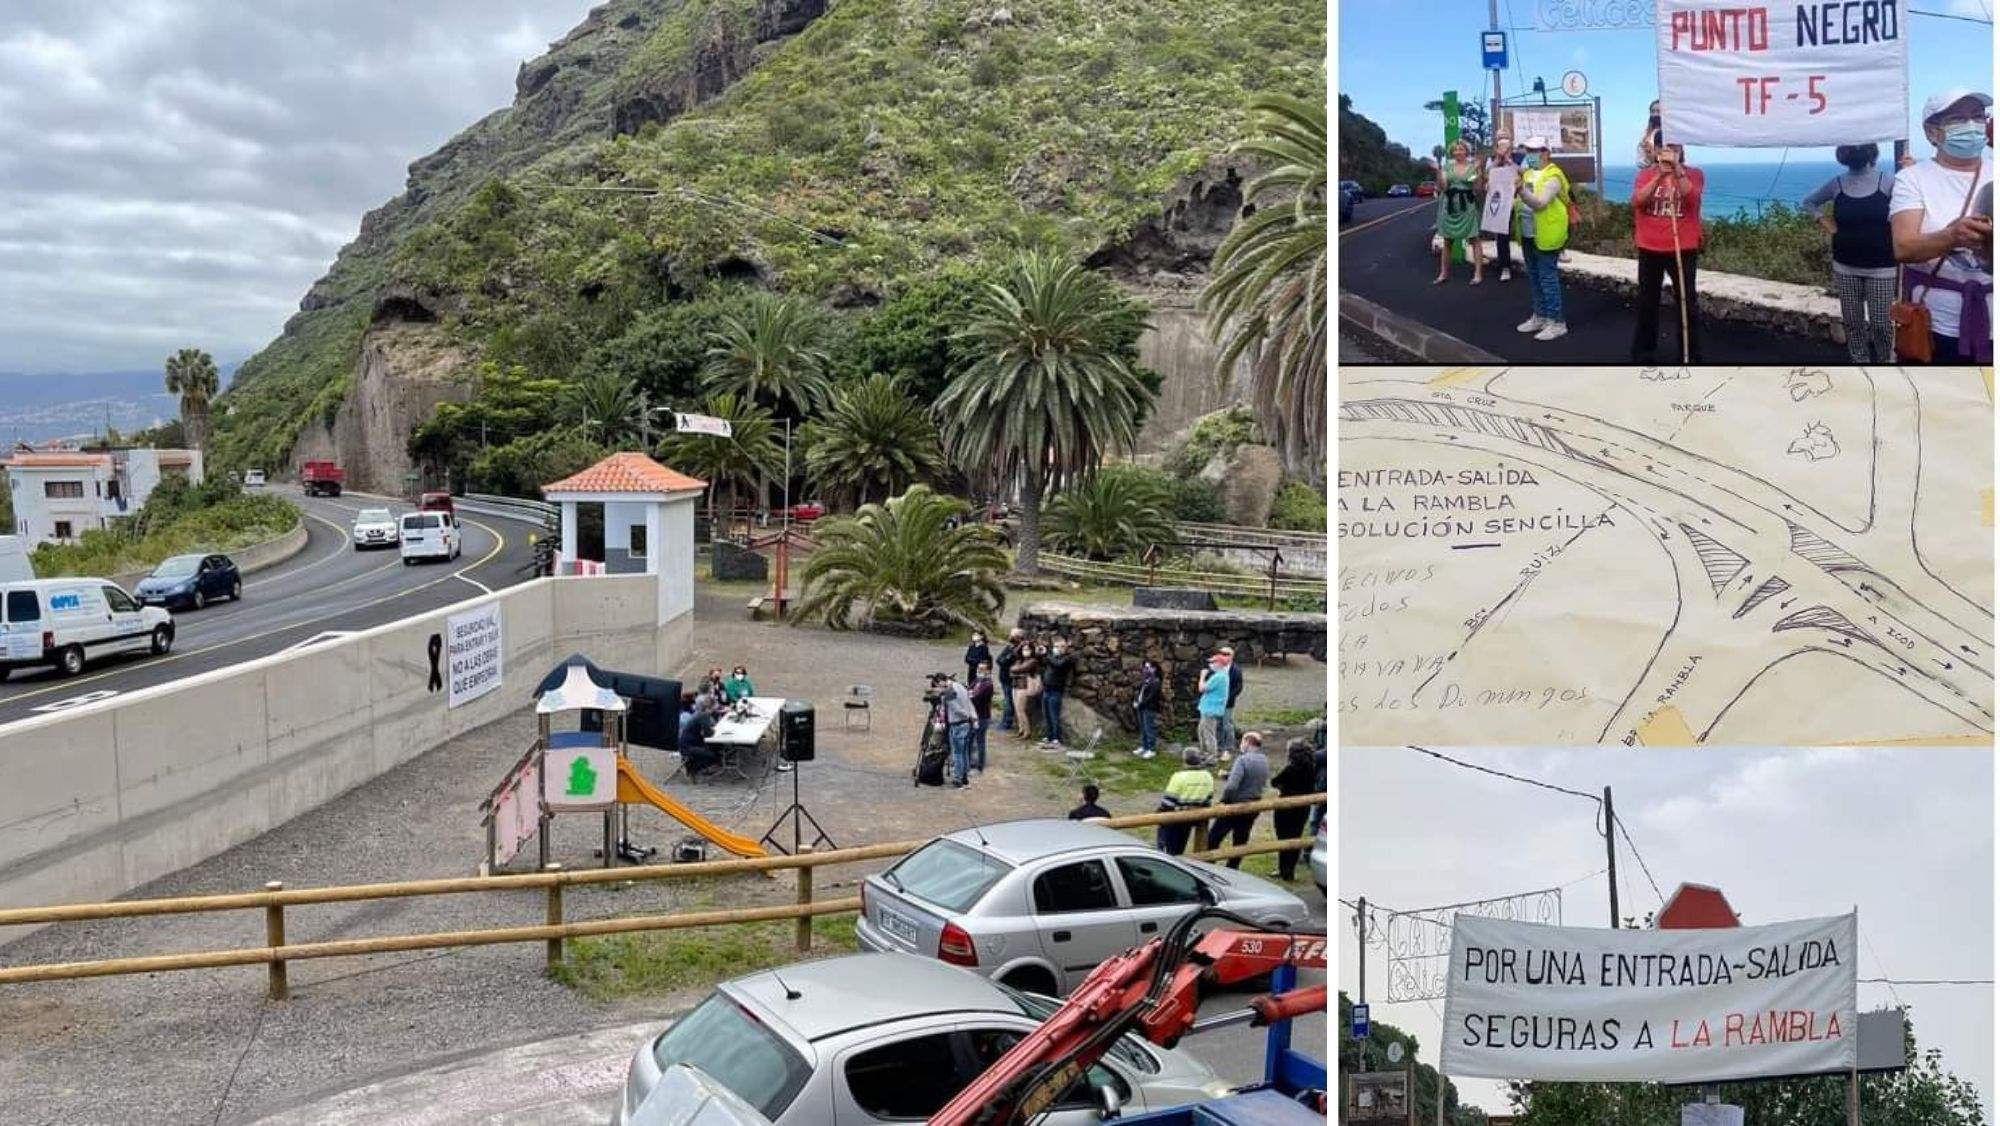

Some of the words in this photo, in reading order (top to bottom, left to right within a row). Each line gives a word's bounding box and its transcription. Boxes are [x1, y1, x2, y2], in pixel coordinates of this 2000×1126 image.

[1672, 7, 1768, 51] PUNTO
[1796, 0, 1898, 47] NEGRO
[1362, 496, 1395, 512] LA
[1414, 494, 1516, 511] RAMBLA
[1656, 655, 1703, 704] RAMBLA
[1241, 940, 1262, 954] 530
[1465, 947, 1517, 984] POR
[1525, 949, 1587, 985] UNA
[1462, 1013, 1621, 1051] SEGURAS
[1633, 1020, 1654, 1049] A
[1671, 1019, 1711, 1048] LA
[1724, 1011, 1842, 1046] RAMBLA
